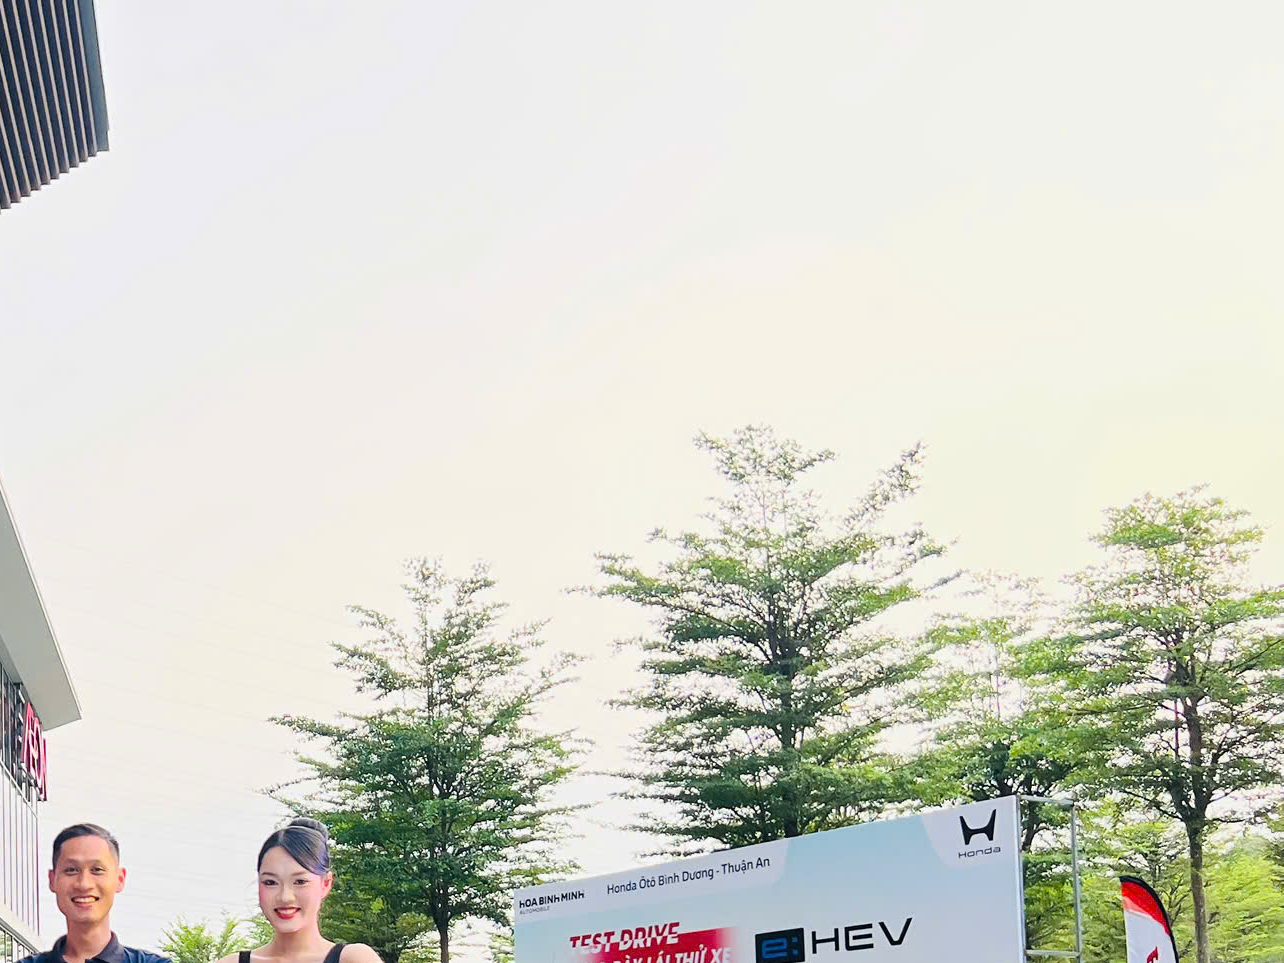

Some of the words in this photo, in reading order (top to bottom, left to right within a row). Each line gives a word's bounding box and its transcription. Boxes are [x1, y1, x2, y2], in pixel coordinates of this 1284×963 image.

[958, 847, 1001, 858] Honda
[607, 880, 637, 895] Honda
[682, 868, 714, 884] Dương
[721, 861, 754, 876] Thuận
[756, 857, 771, 869] An
[569, 930, 615, 954] TEST
[619, 922, 680, 950] DRIVE
